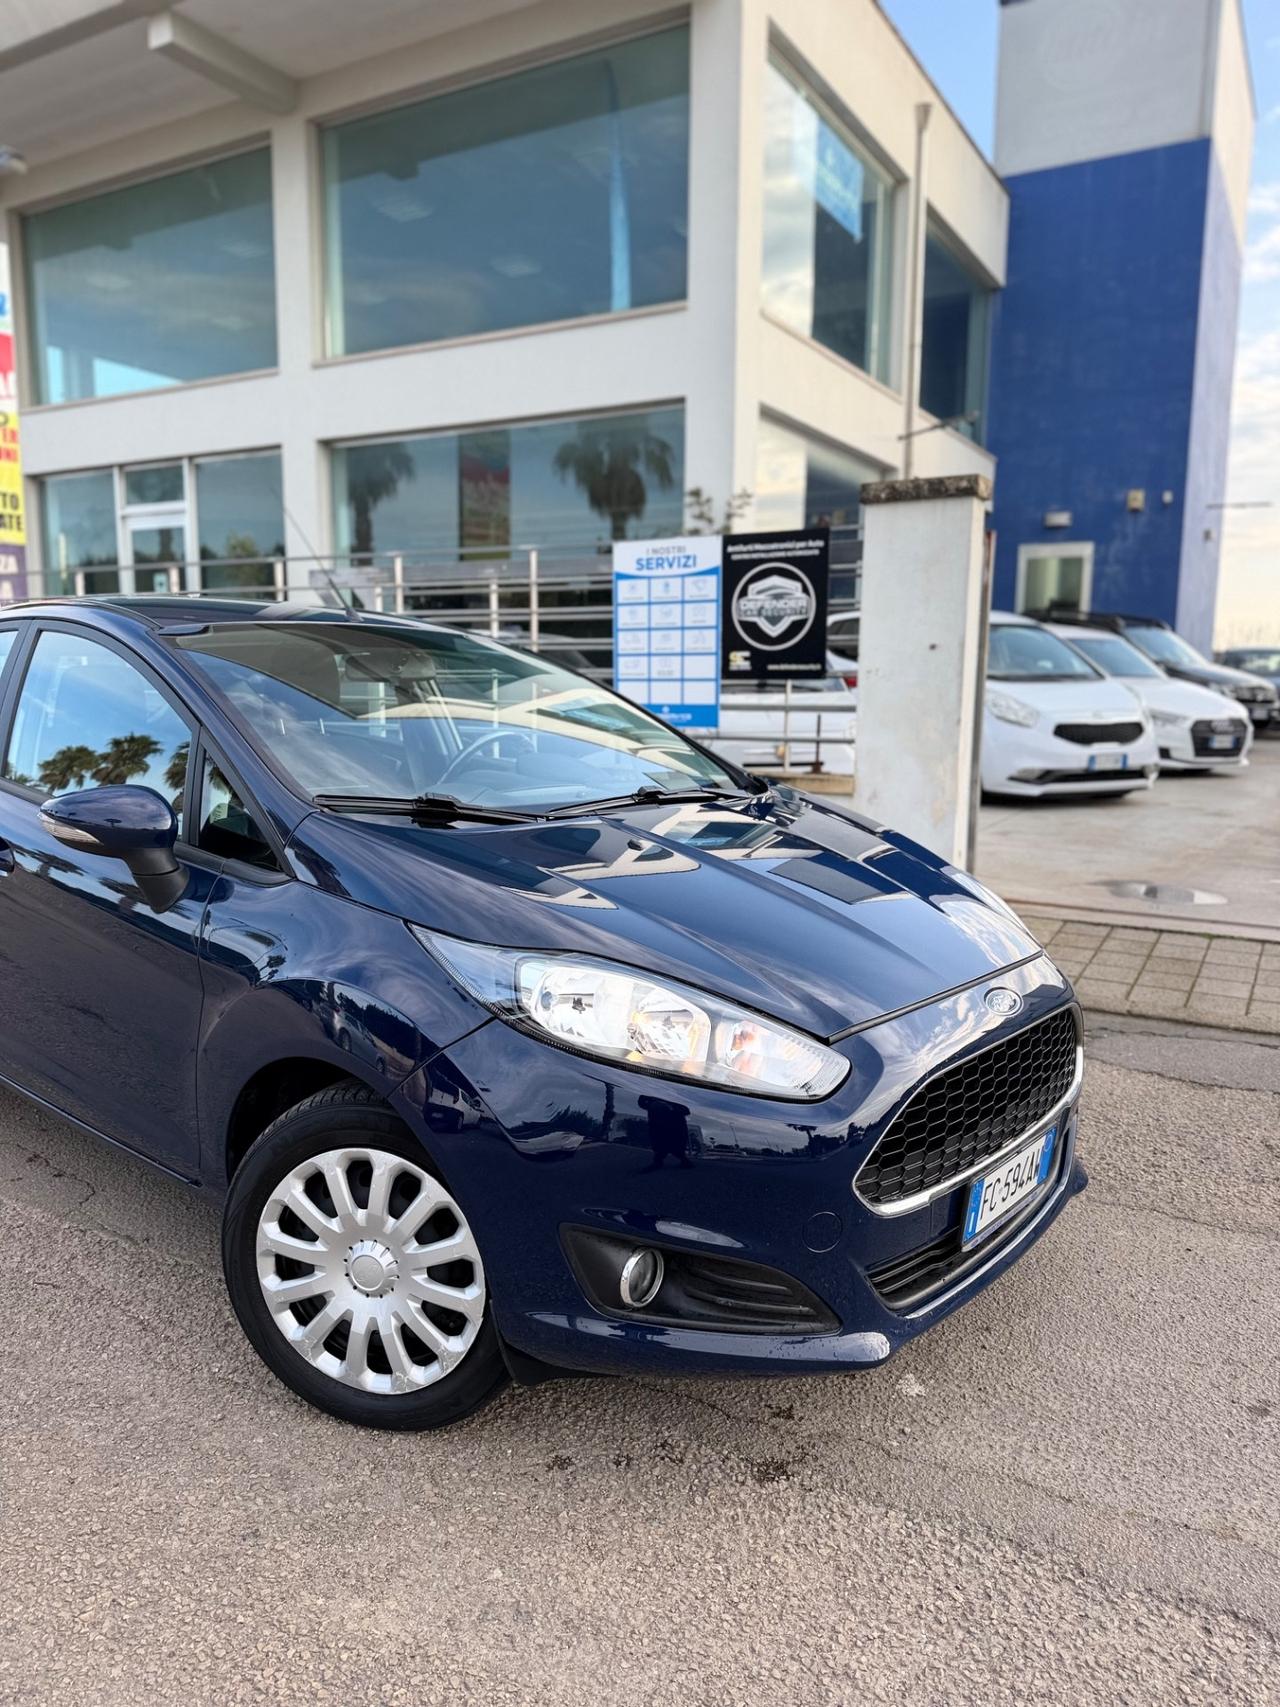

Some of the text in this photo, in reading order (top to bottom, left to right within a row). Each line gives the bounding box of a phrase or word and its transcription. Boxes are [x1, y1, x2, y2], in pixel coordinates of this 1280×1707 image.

[652, 546, 687, 555] NOSTRI
[636, 554, 697, 571] SERVIZI
[740, 598, 807, 610] DEFENDER
